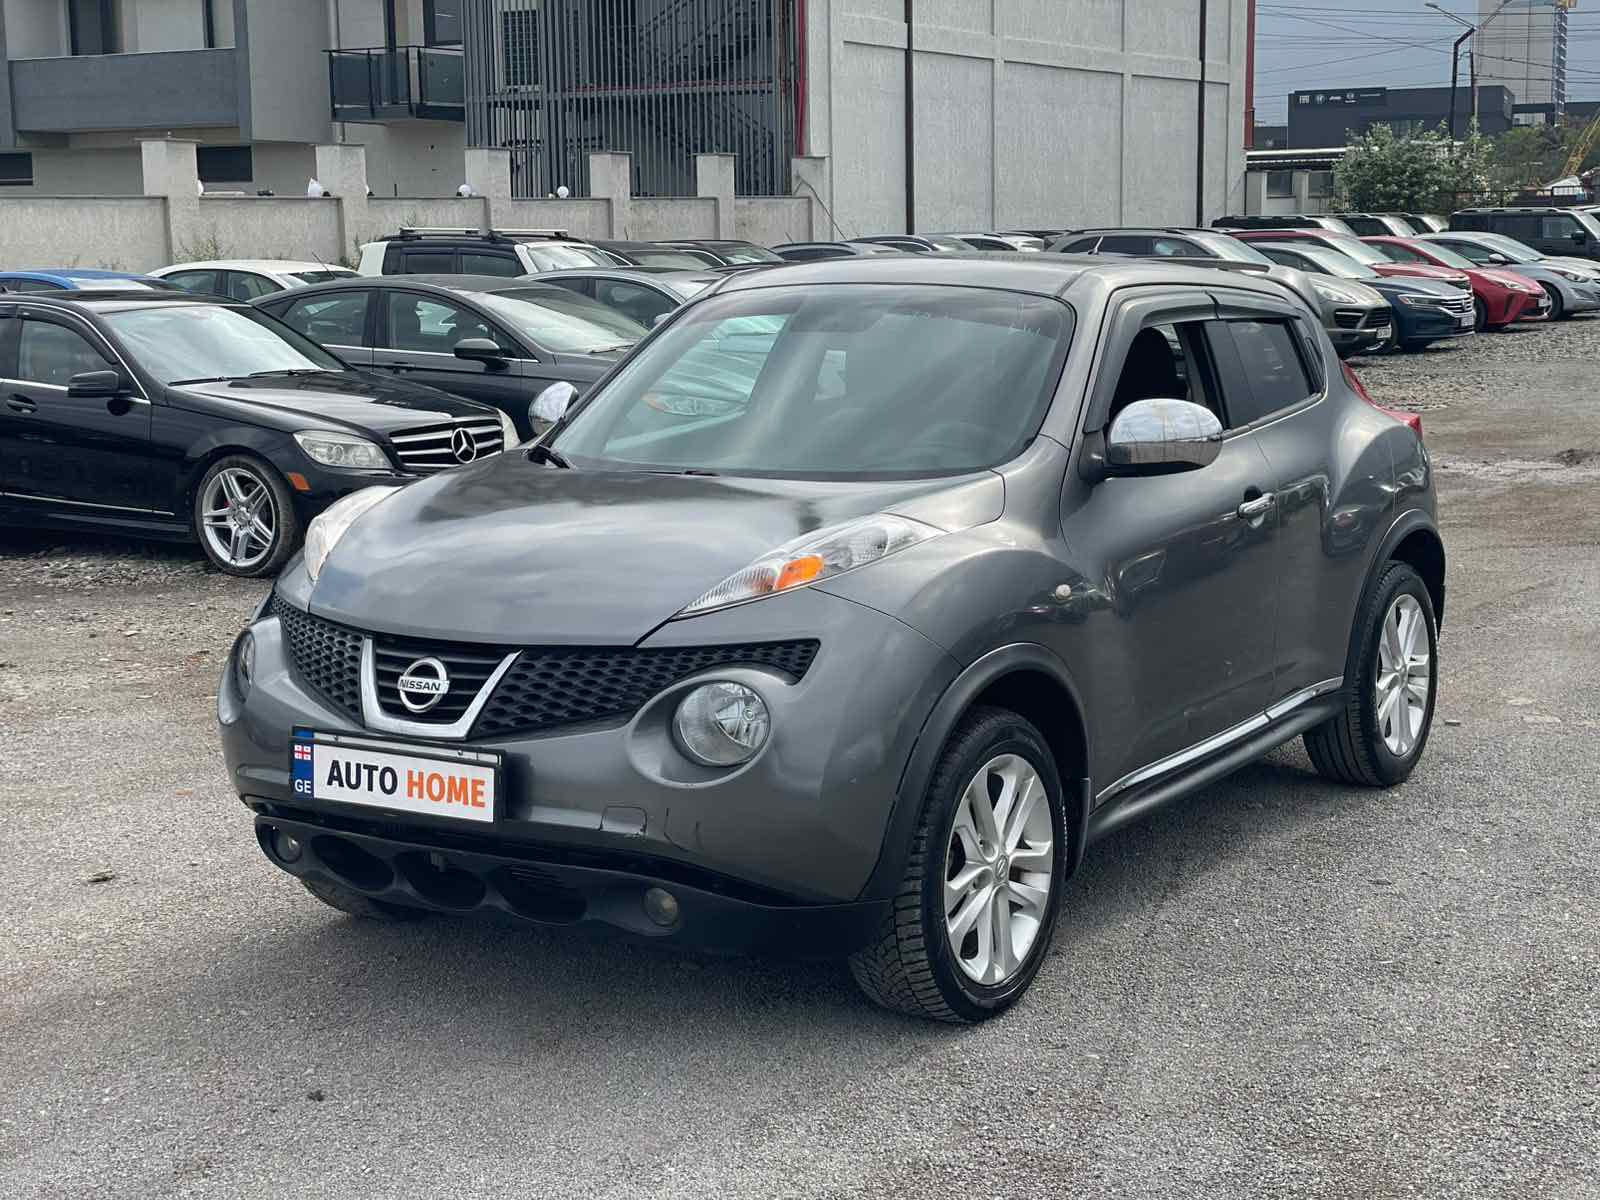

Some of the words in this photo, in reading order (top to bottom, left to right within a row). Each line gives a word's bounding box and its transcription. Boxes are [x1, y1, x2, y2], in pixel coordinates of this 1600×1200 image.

[400, 678, 441, 692] NISSAN
[294, 779, 312, 794] GE
[326, 759, 398, 795] AUTO
[407, 769, 486, 808] HOME
